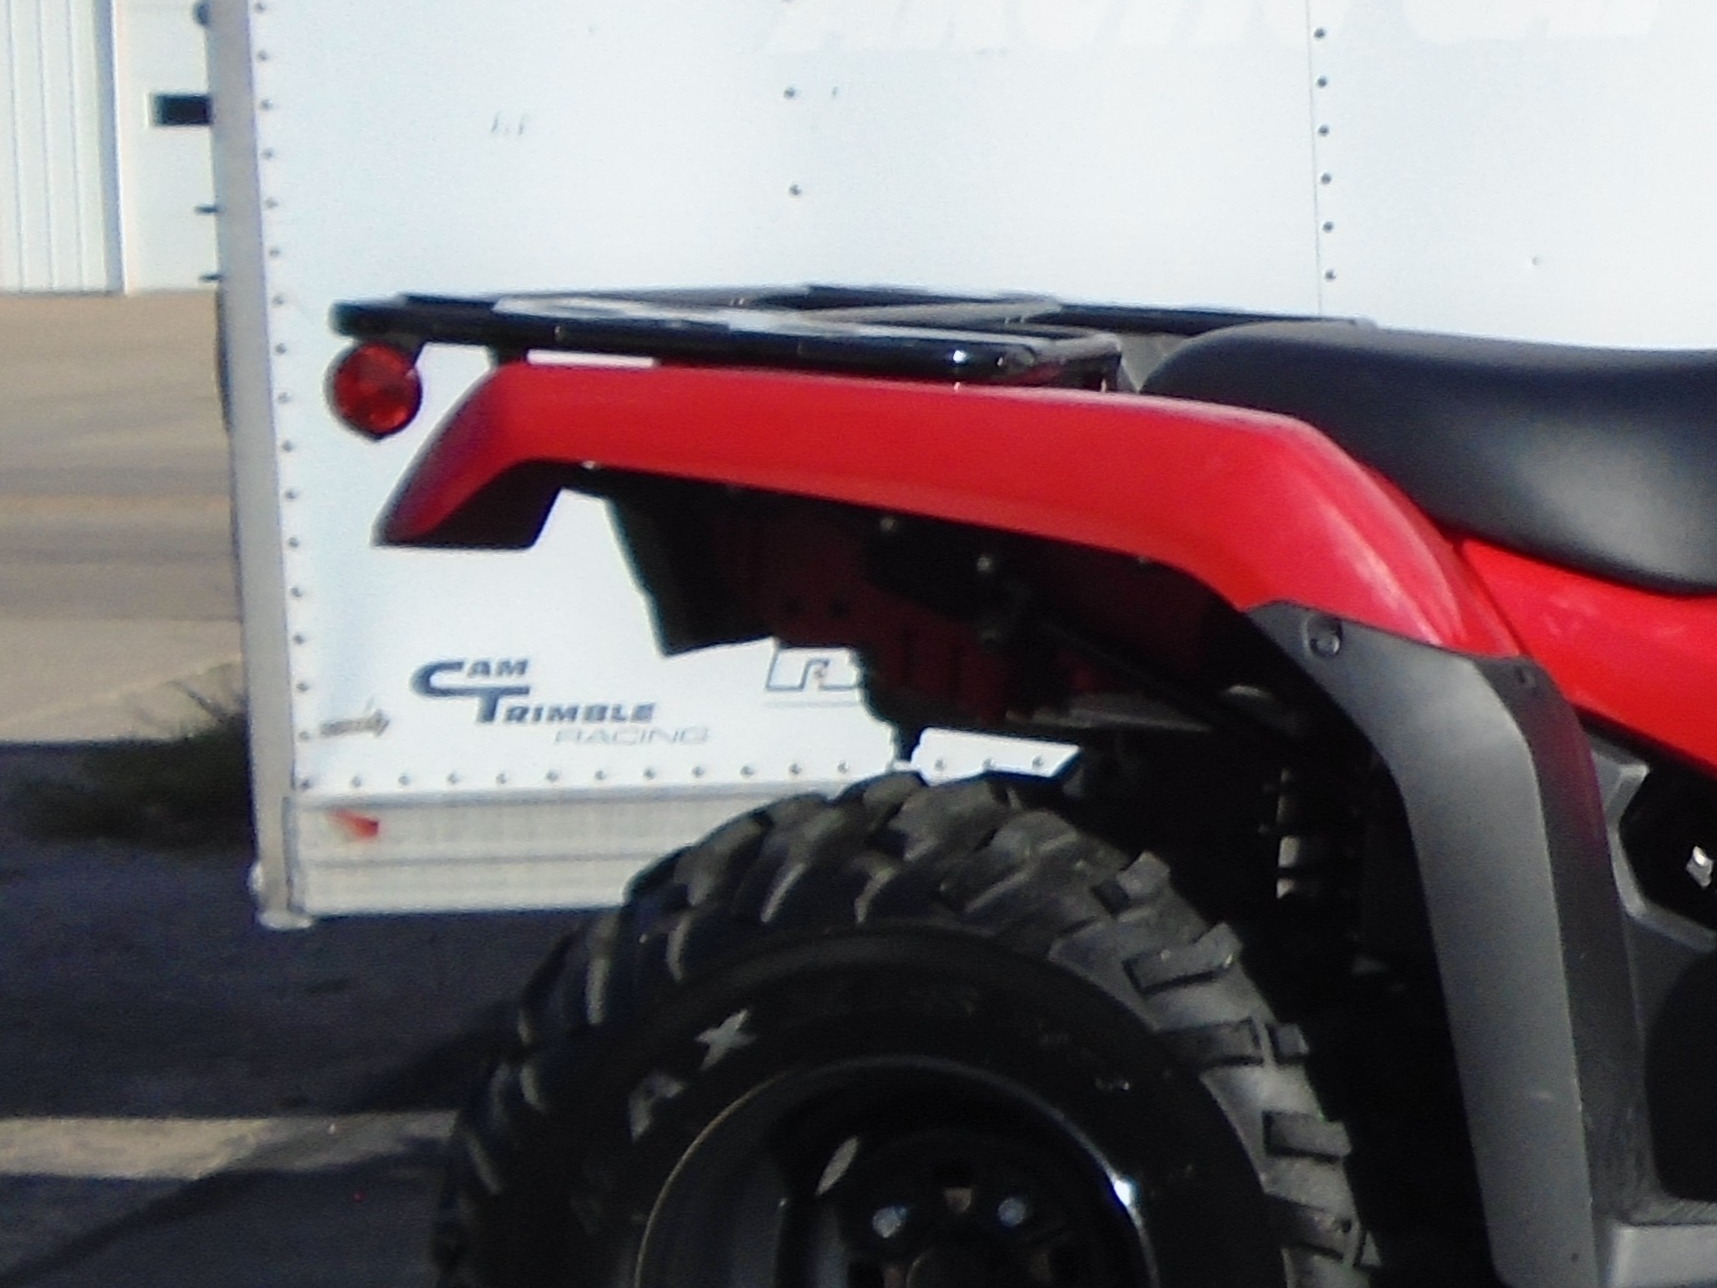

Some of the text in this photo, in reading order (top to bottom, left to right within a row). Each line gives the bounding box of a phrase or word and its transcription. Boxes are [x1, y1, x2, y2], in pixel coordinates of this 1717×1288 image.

[410, 657, 531, 698] CAM
[460, 685, 658, 725] TRIMBLE
[553, 725, 711, 747] RACING
